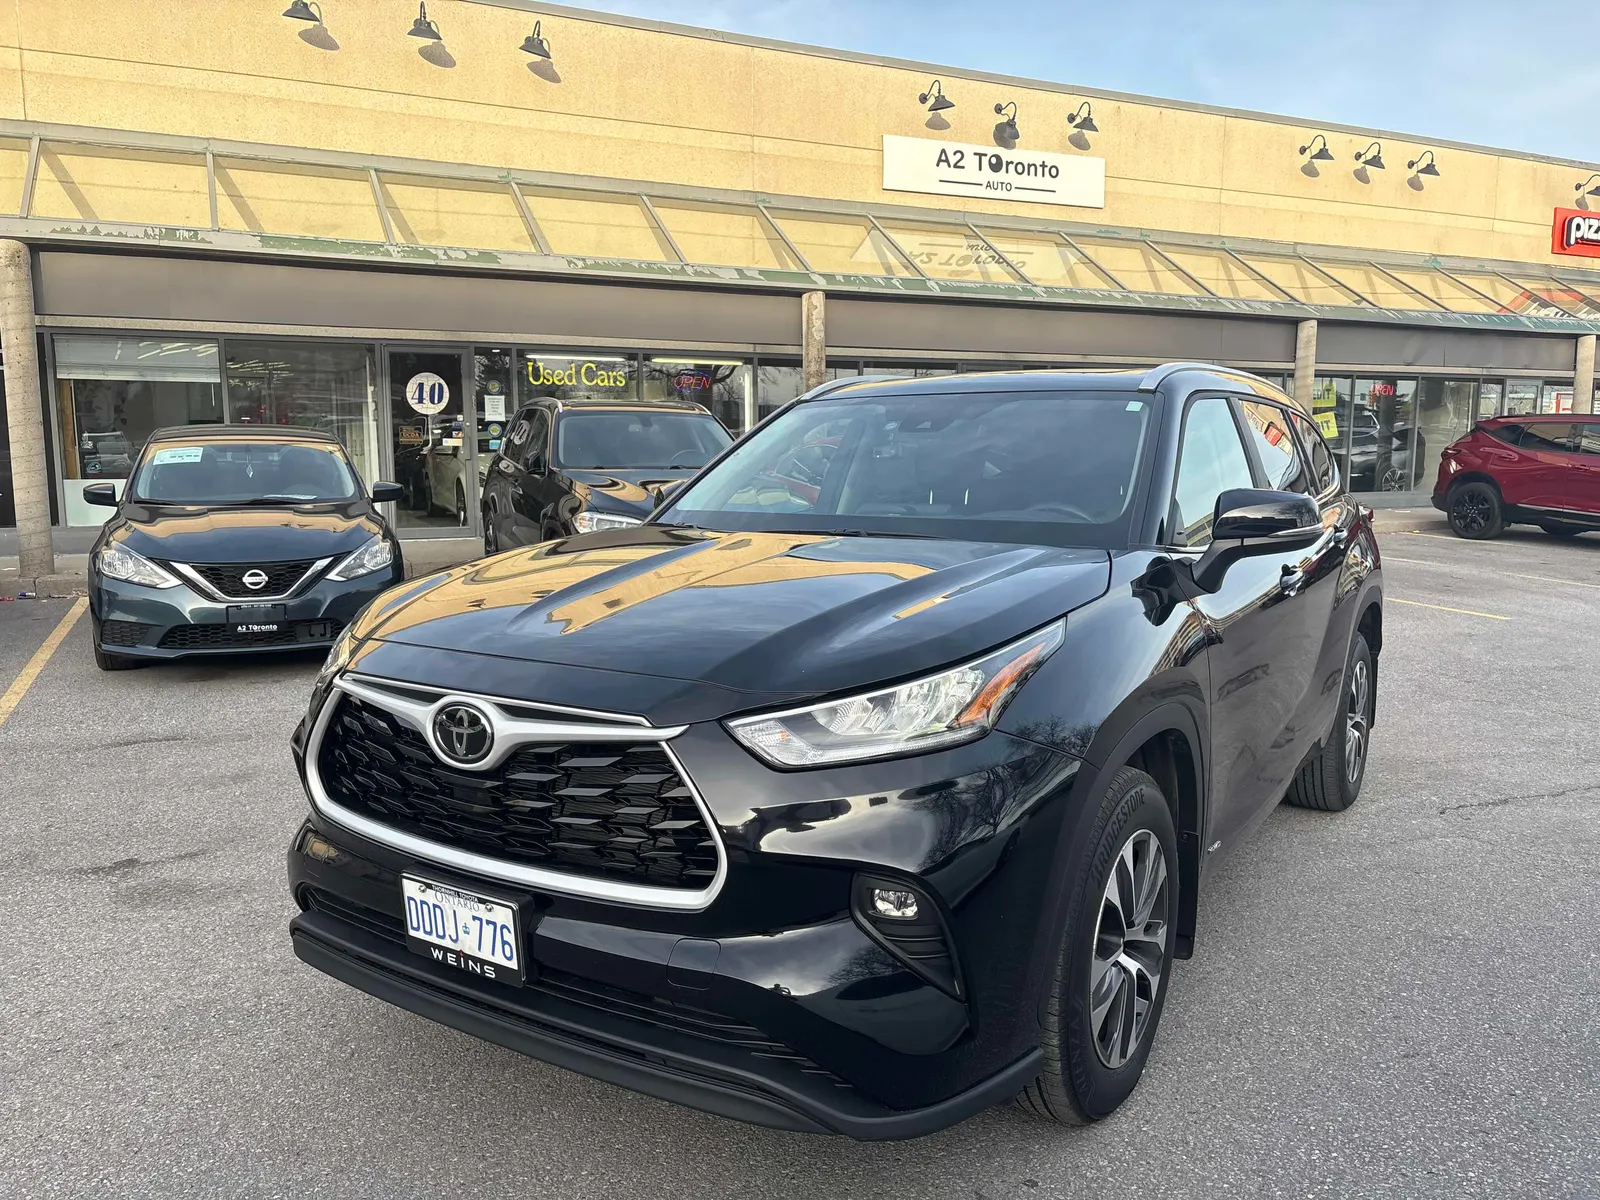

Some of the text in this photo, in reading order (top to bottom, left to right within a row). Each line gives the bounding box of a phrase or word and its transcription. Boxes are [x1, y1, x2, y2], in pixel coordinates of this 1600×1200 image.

[936, 148, 965, 170] A2
[985, 180, 1013, 192] AUTO
[526, 362, 626, 388] Used Cars
[673, 375, 712, 390] OPEN
[410, 381, 445, 406] 40
[1370, 383, 1394, 396] OPEN
[1090, 787, 1145, 890] BRIDGESTONE
[431, 884, 479, 903] THORNHILL TOYOTA
[434, 890, 480, 913] ONTARIO
[406, 895, 514, 962] DDDJ 776
[1071, 1016, 1088, 1093] ALENZA
